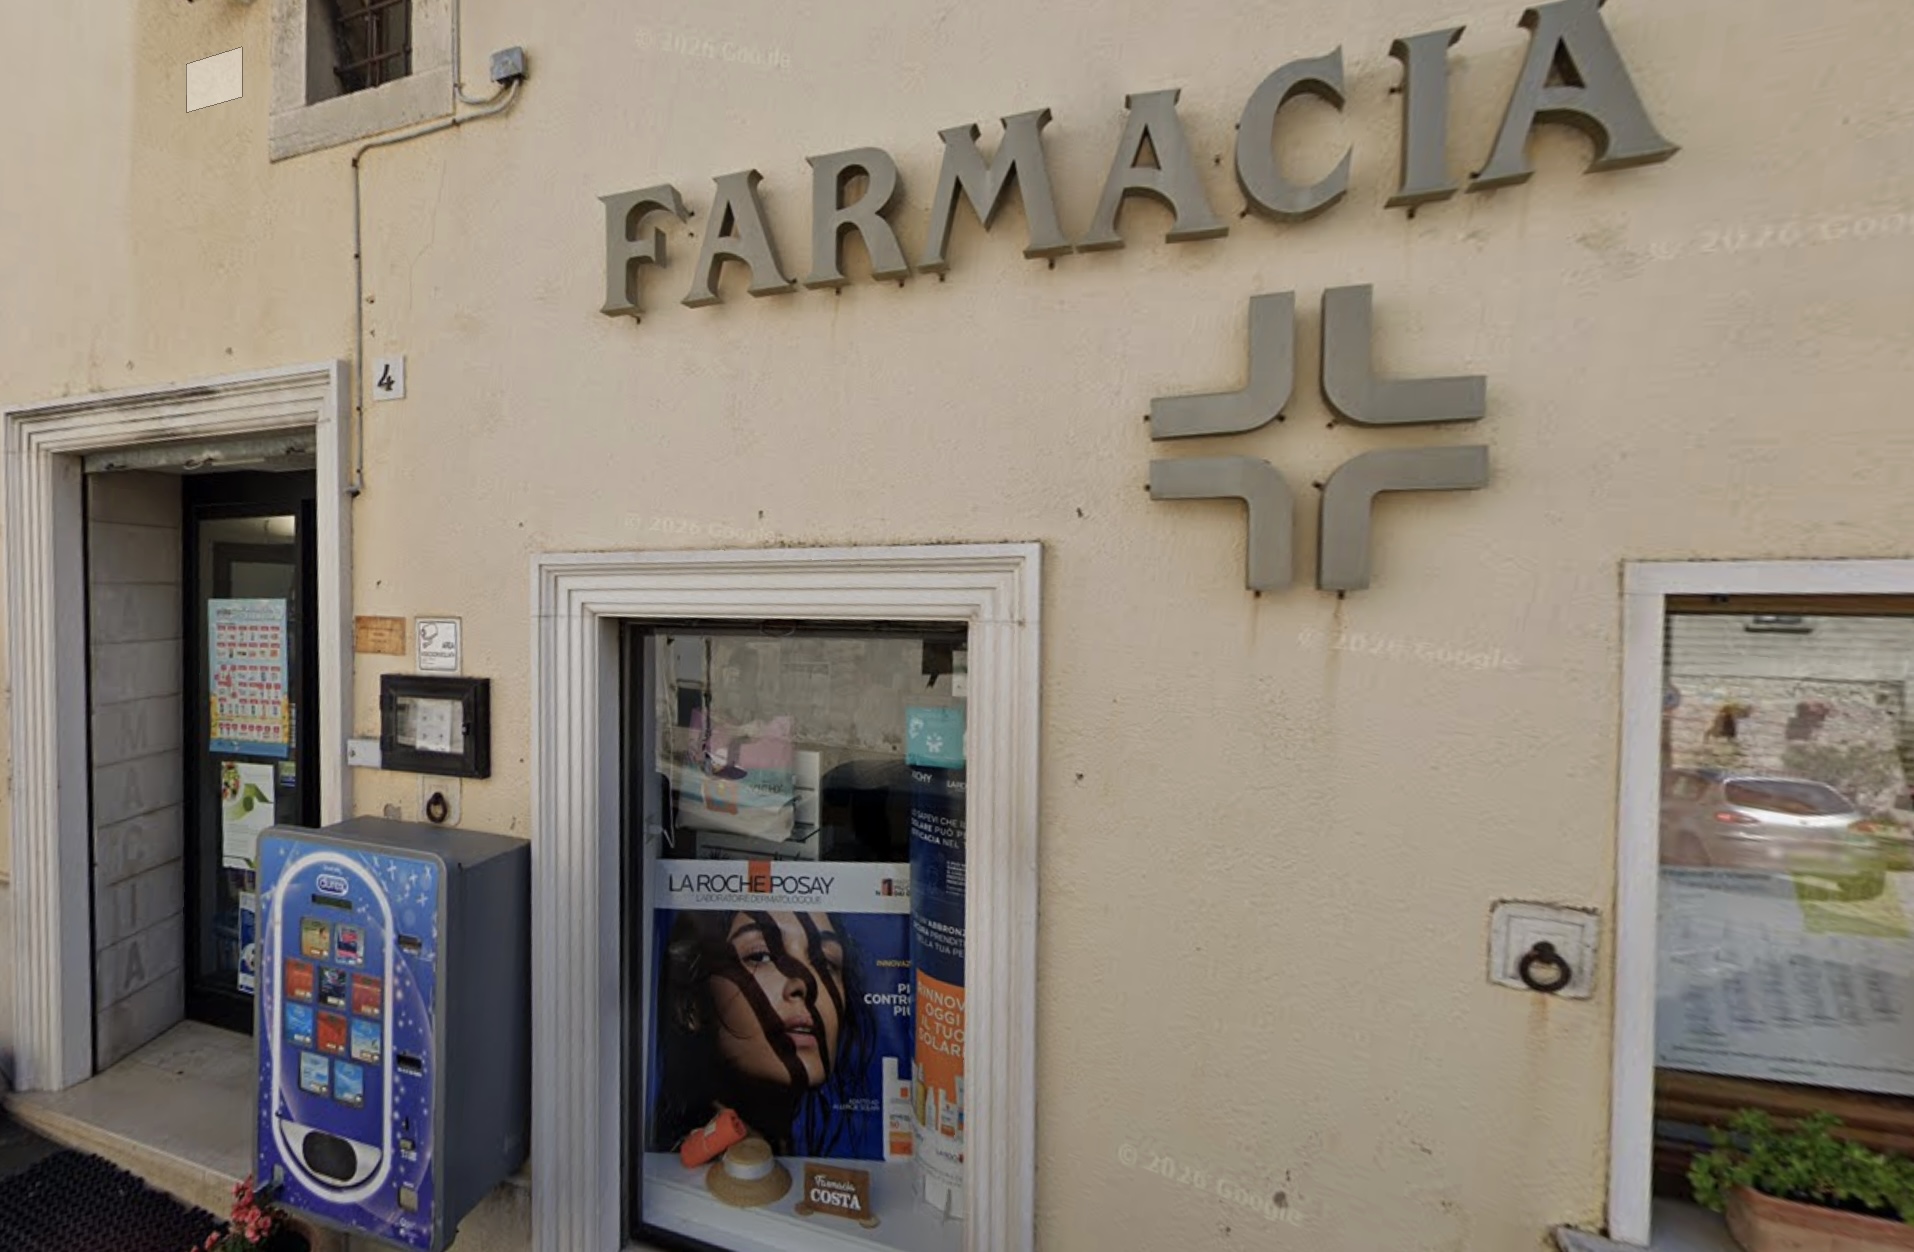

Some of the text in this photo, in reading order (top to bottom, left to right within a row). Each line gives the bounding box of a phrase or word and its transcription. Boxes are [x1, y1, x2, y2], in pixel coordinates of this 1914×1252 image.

[597, 0, 1681, 317] FARMACIA
[377, 363, 396, 392] 4
[669, 874, 835, 895] LA ROCHE POSAY
[935, 941, 951, 954] TUA
[921, 1014, 931, 1031] IL
[925, 1002, 960, 1026] OGGI
[810, 1187, 862, 1212] COSTA
